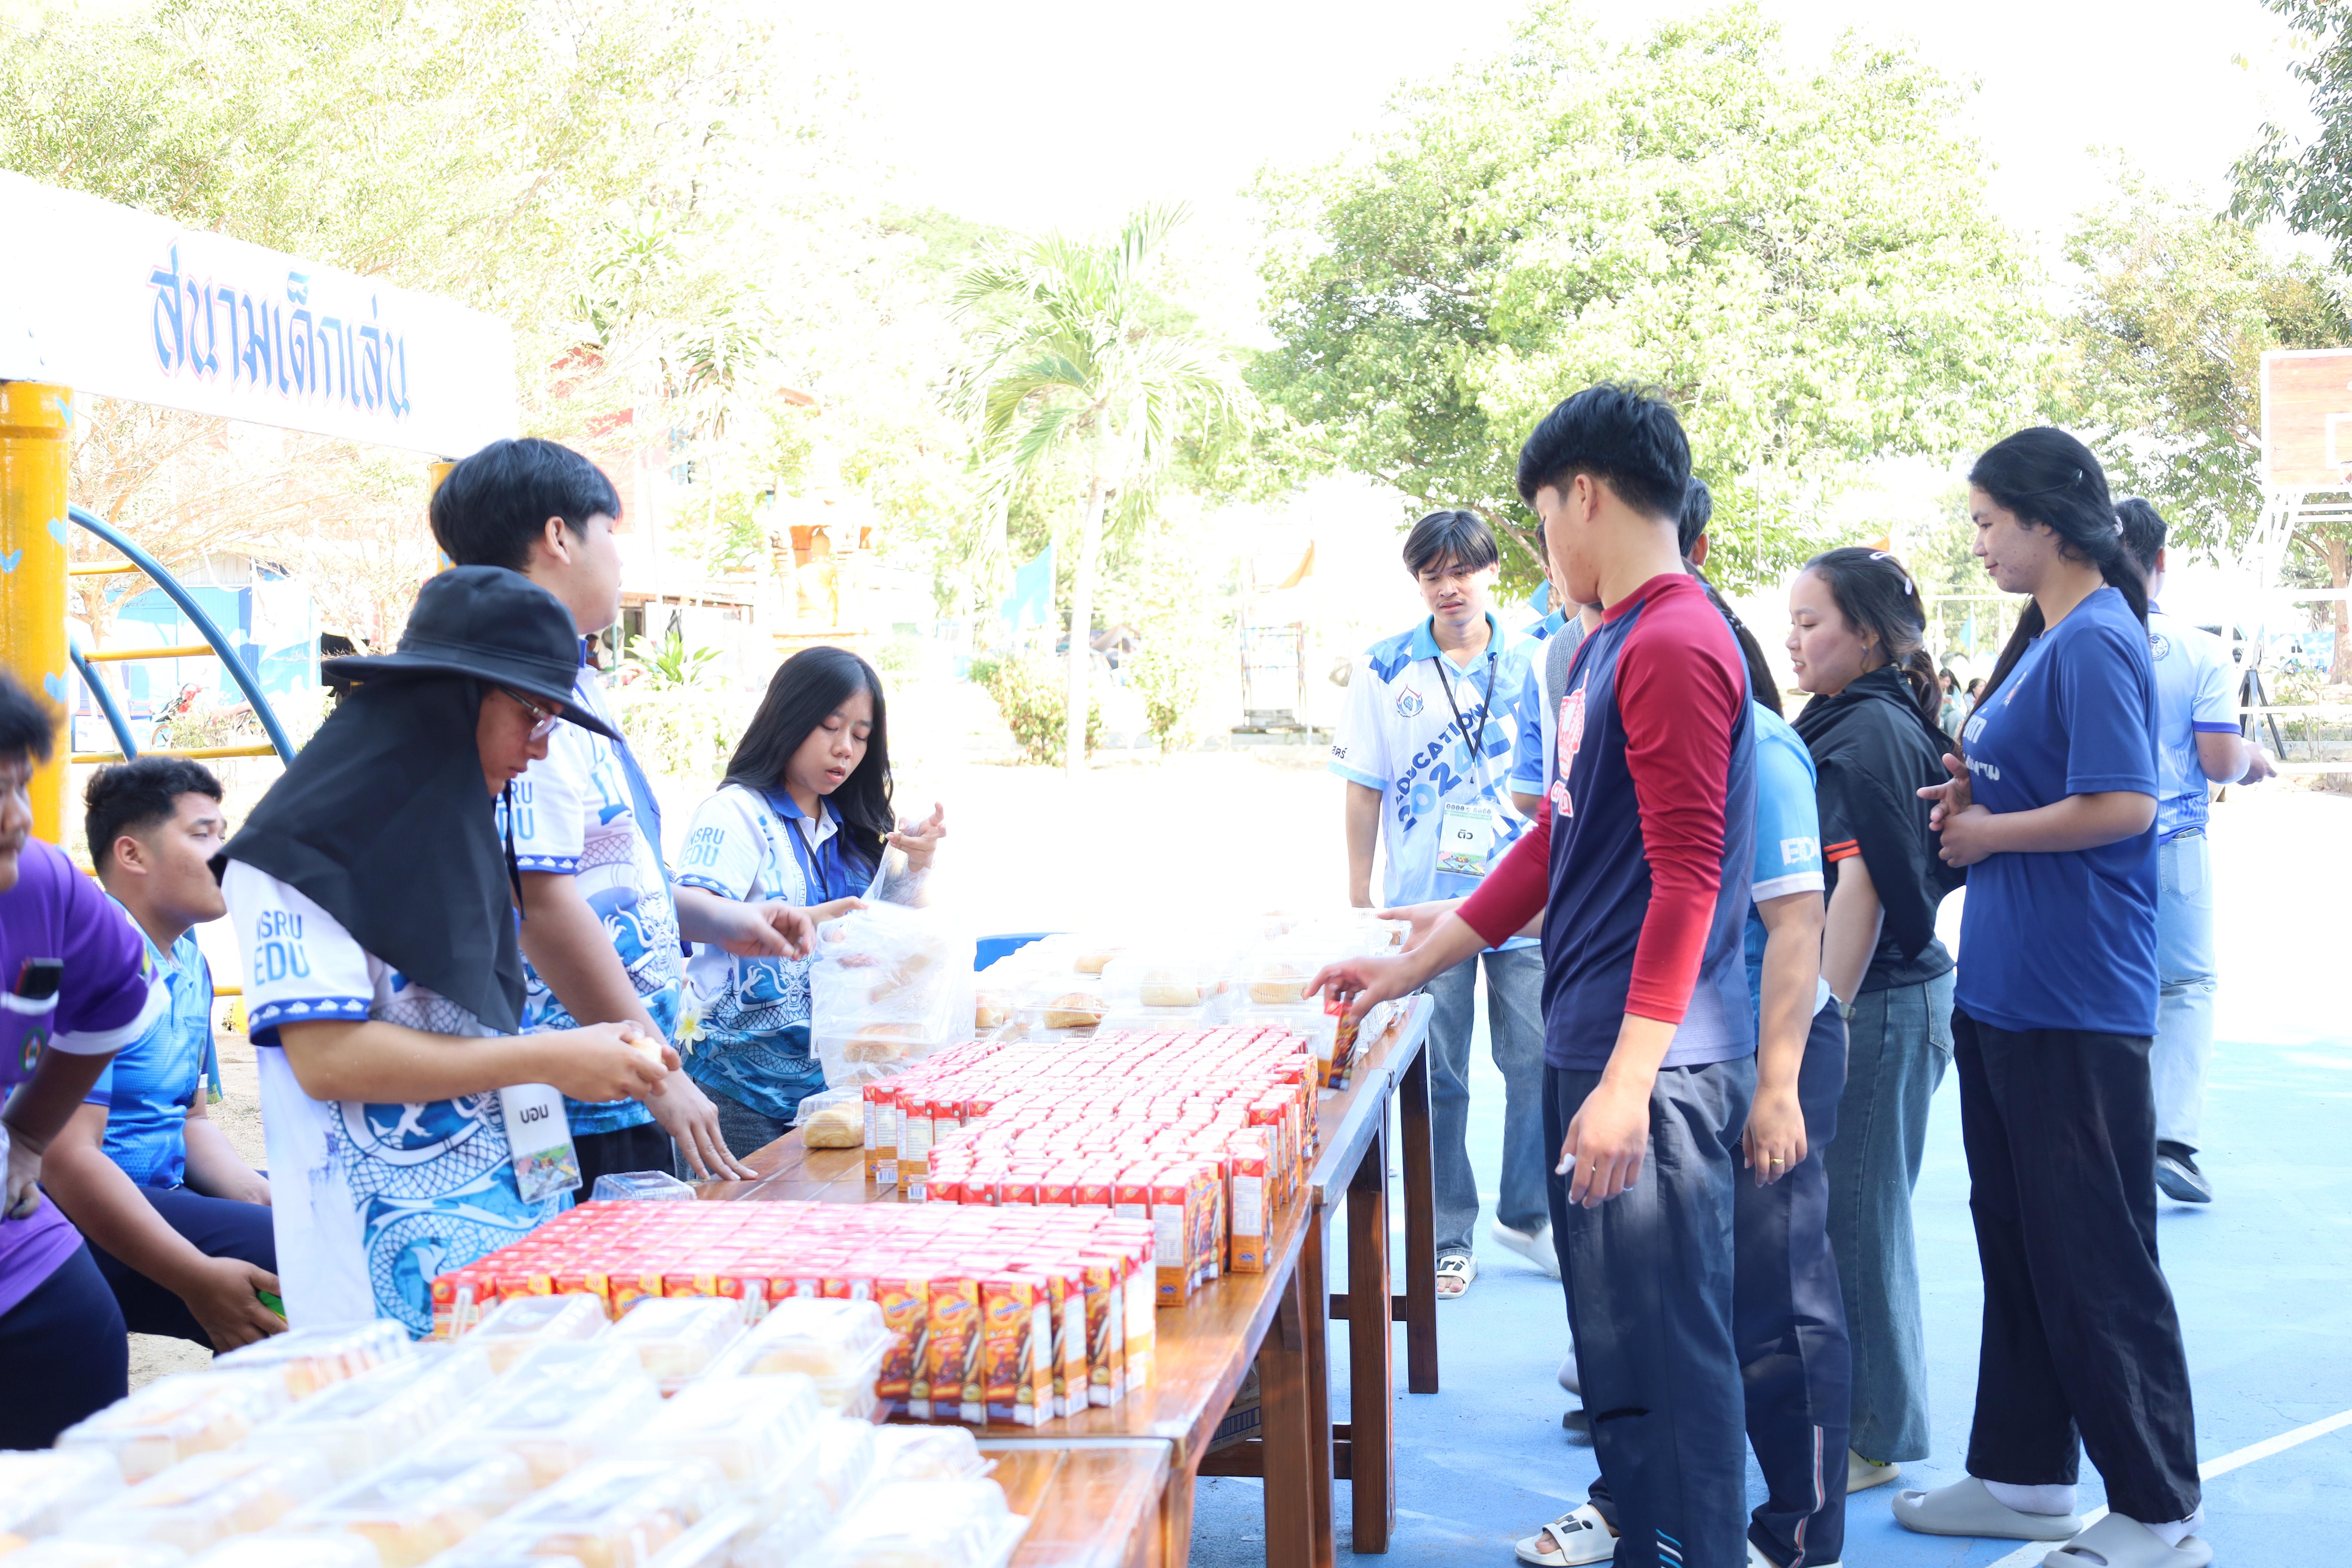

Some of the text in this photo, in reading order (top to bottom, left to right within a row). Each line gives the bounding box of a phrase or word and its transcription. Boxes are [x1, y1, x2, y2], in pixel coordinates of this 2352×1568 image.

[147, 237, 411, 421] สนามเด็กเล่น
[498, 807, 534, 840] DU
[1458, 829, 1473, 839] ติว
[681, 844, 719, 868] EDU
[255, 941, 310, 987] EDU
